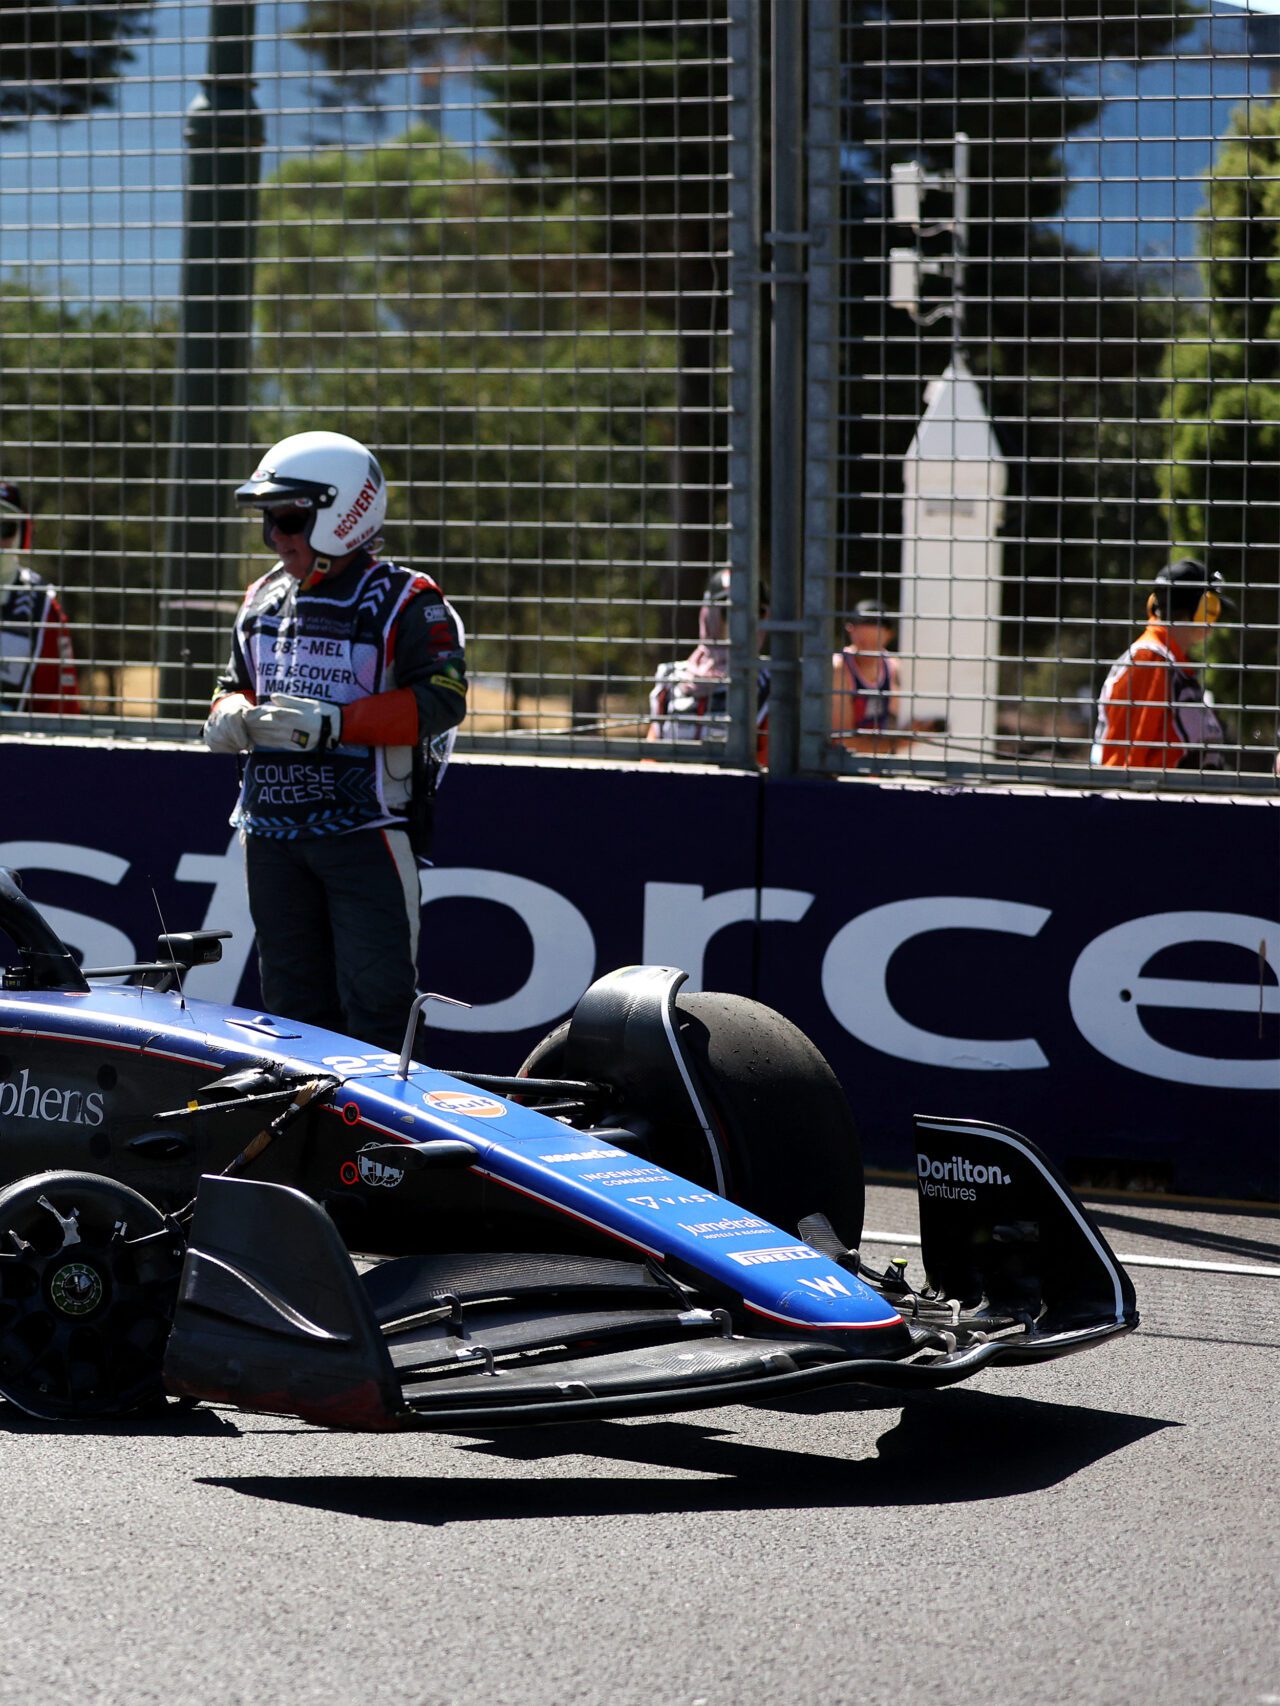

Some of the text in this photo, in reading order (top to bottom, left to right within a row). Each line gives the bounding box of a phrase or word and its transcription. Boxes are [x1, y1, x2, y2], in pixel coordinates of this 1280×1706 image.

[333, 478, 378, 540] RECOVERY
[254, 764, 335, 784] COURSE
[258, 785, 336, 804] ACCESS
[433, 1098, 496, 1112] Gulf
[578, 1167, 664, 1183] INGENUITY
[602, 1175, 675, 1187] COMMERCE
[919, 1179, 977, 1201] Ventures
[659, 1194, 718, 1206] VAST
[677, 1216, 769, 1237] Jumeirah
[726, 1245, 822, 1266] PIRELLI
